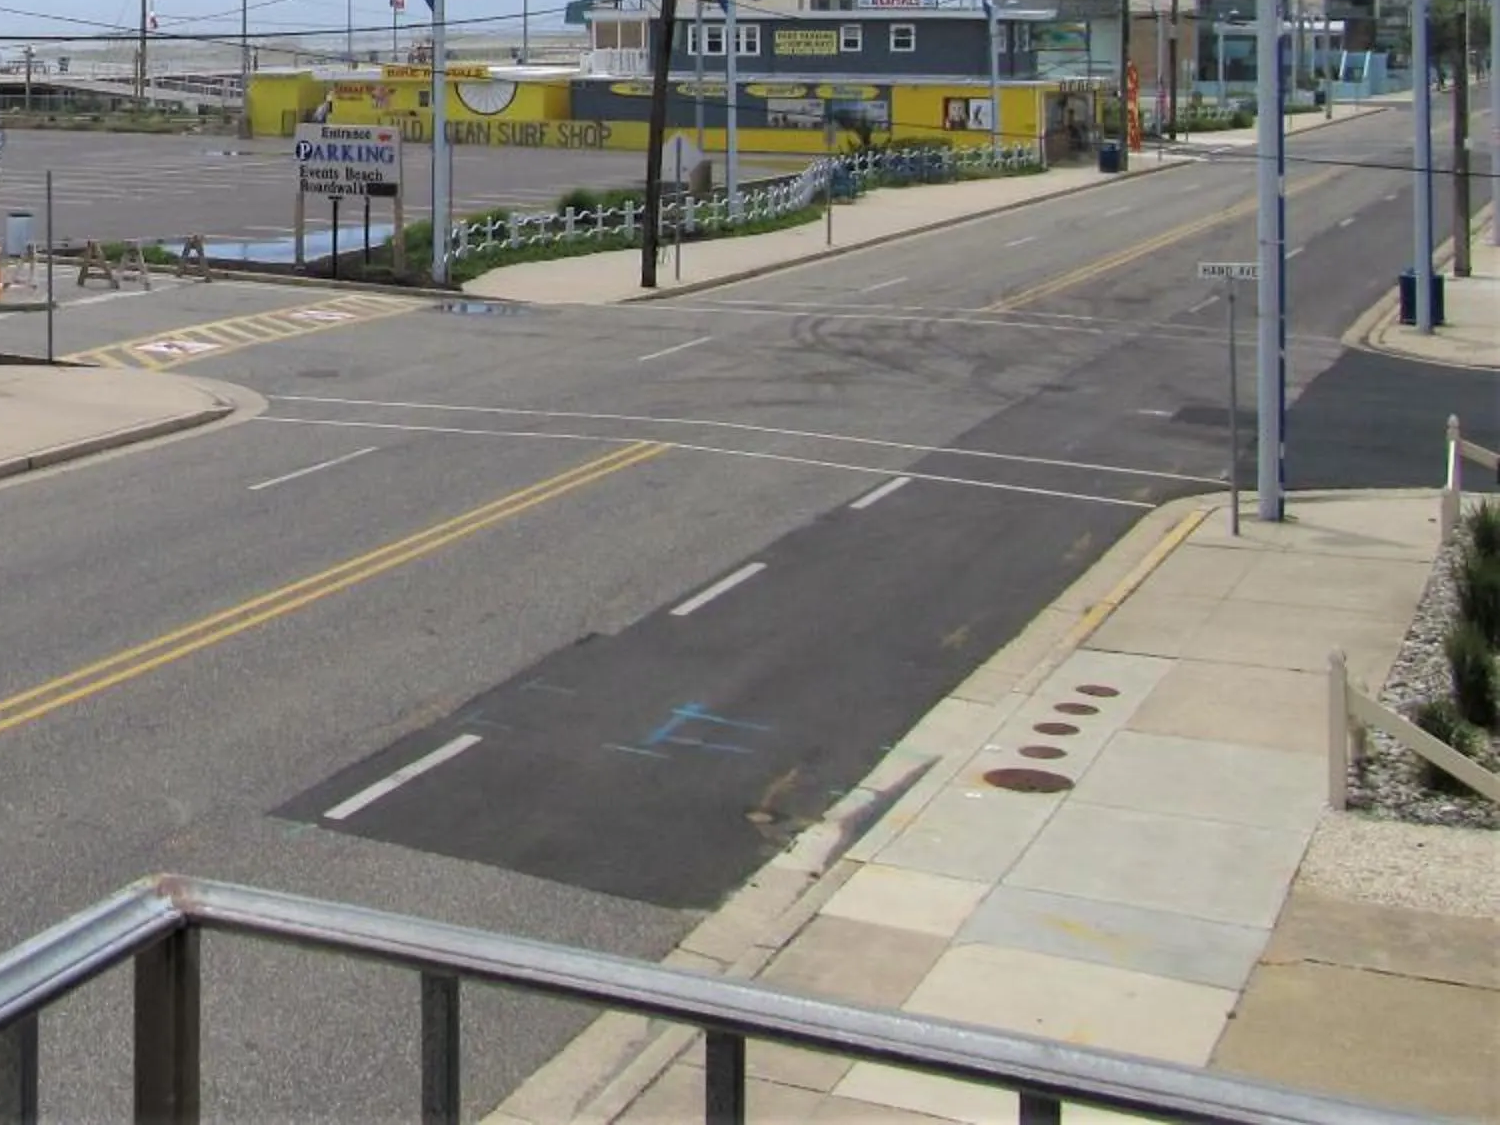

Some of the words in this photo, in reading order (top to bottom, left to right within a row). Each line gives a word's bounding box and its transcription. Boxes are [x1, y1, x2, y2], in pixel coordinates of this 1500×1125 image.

[322, 126, 372, 140] Entrance
[443, 120, 491, 145] CEAN
[499, 121, 546, 146] SURF
[557, 123, 612, 149] SHOP
[298, 140, 395, 164] PARKING
[300, 165, 339, 179] Events
[345, 166, 383, 181] Beach
